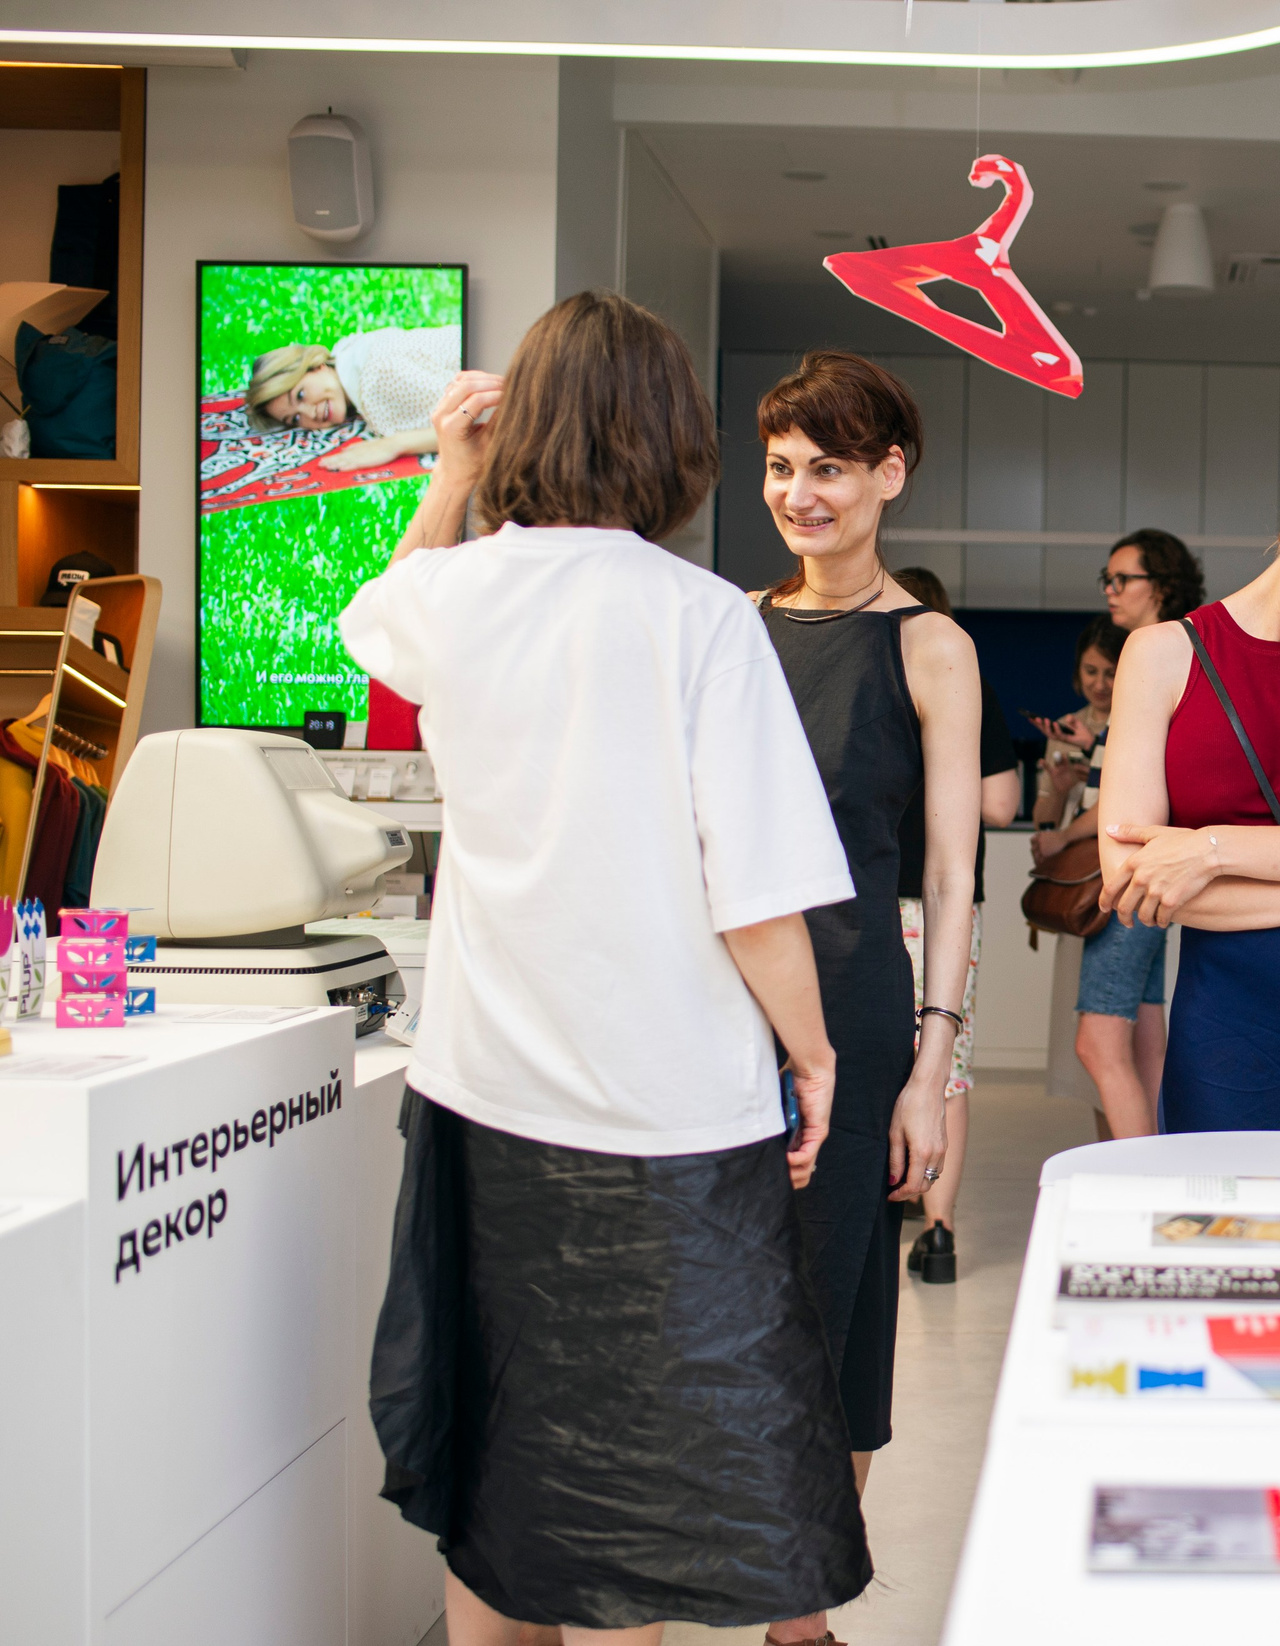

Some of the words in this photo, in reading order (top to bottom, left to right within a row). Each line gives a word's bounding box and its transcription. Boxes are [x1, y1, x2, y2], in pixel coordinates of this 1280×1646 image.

[255, 670, 267, 683] И
[270, 673, 293, 685] его
[294, 673, 344, 685] можно
[116, 1067, 342, 1202] Интерьерный
[114, 1188, 229, 1285] декор
